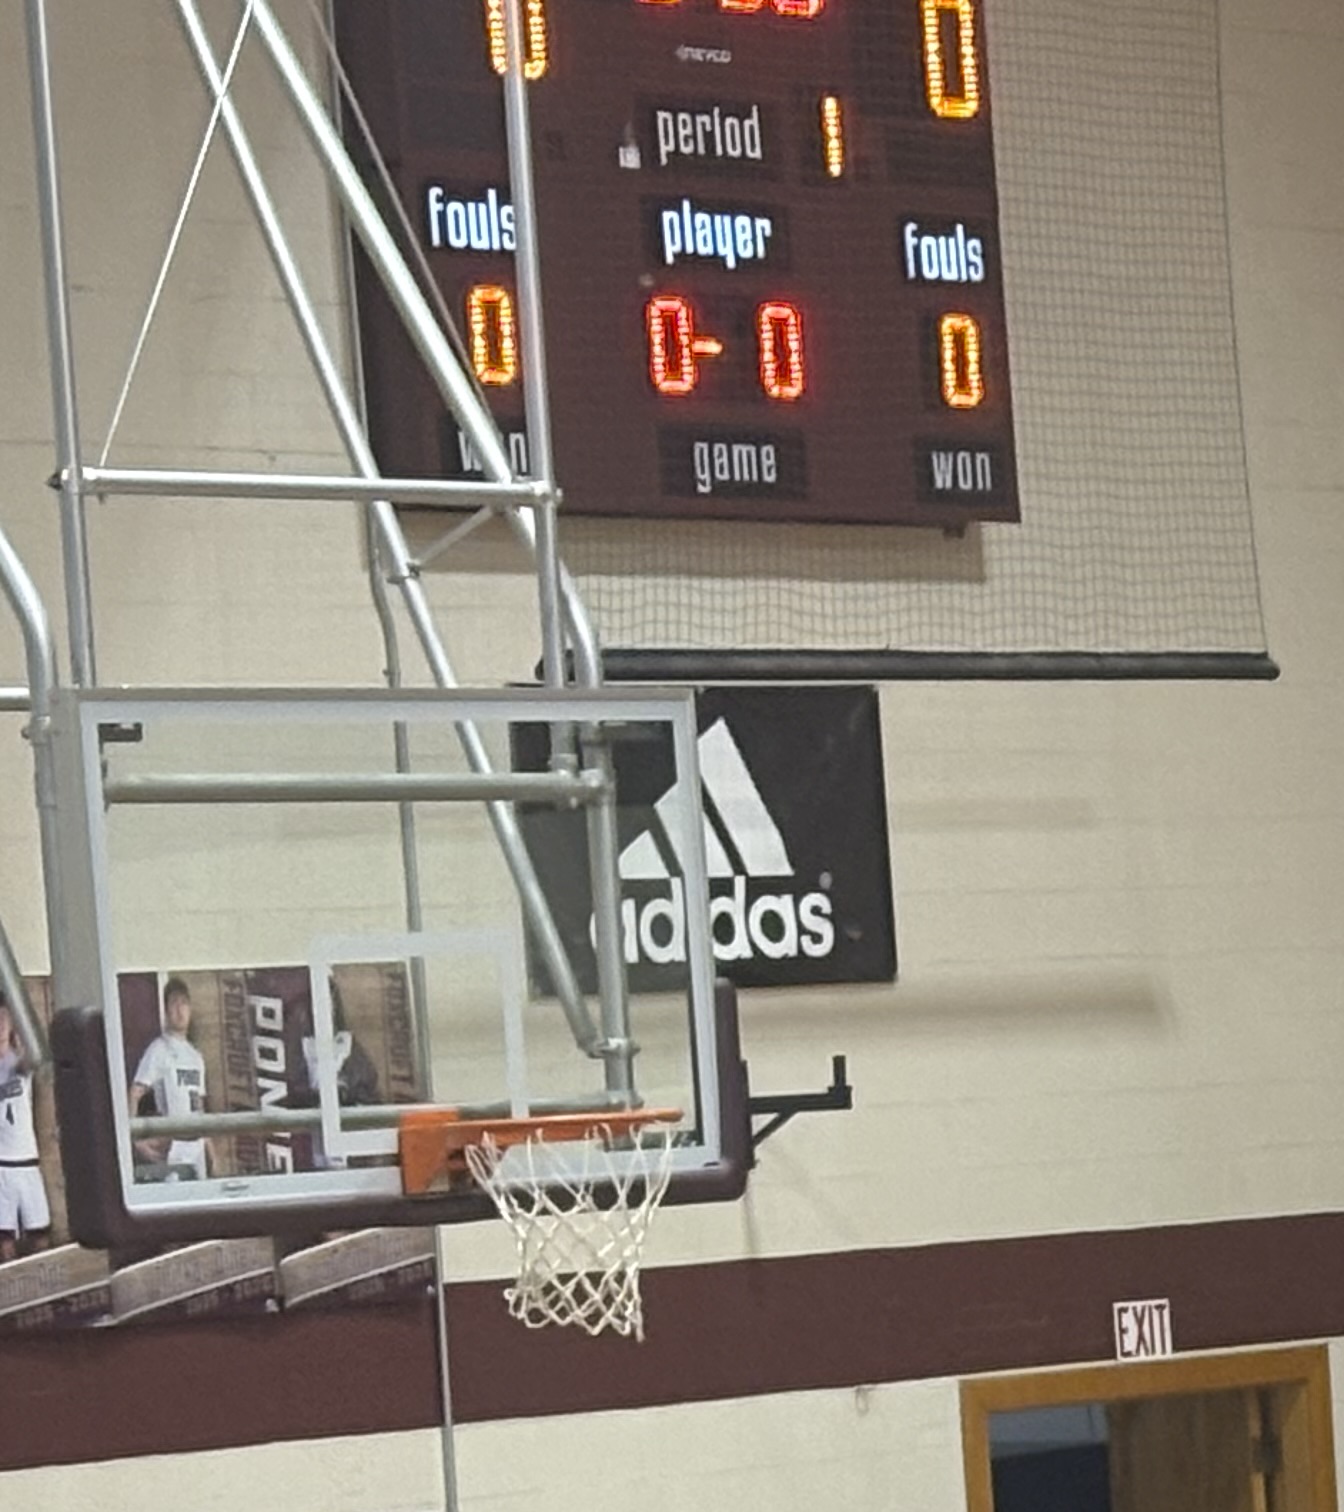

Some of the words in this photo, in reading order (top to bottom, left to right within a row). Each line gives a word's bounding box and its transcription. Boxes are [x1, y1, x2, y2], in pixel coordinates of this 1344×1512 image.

[920, 0, 979, 118] 0
[656, 105, 762, 166] period
[822, 96, 843, 178] 1
[428, 186, 516, 250] fouls
[662, 199, 772, 269] player
[905, 221, 985, 283] fouls
[467, 284, 517, 387] 0
[758, 302, 803, 398] 0
[939, 312, 984, 409] 0
[458, 429, 529, 474] wn
[693, 440, 777, 493] game
[931, 450, 993, 492] won
[590, 875, 835, 964] addas
[1118, 1304, 1167, 1358] EXIT
